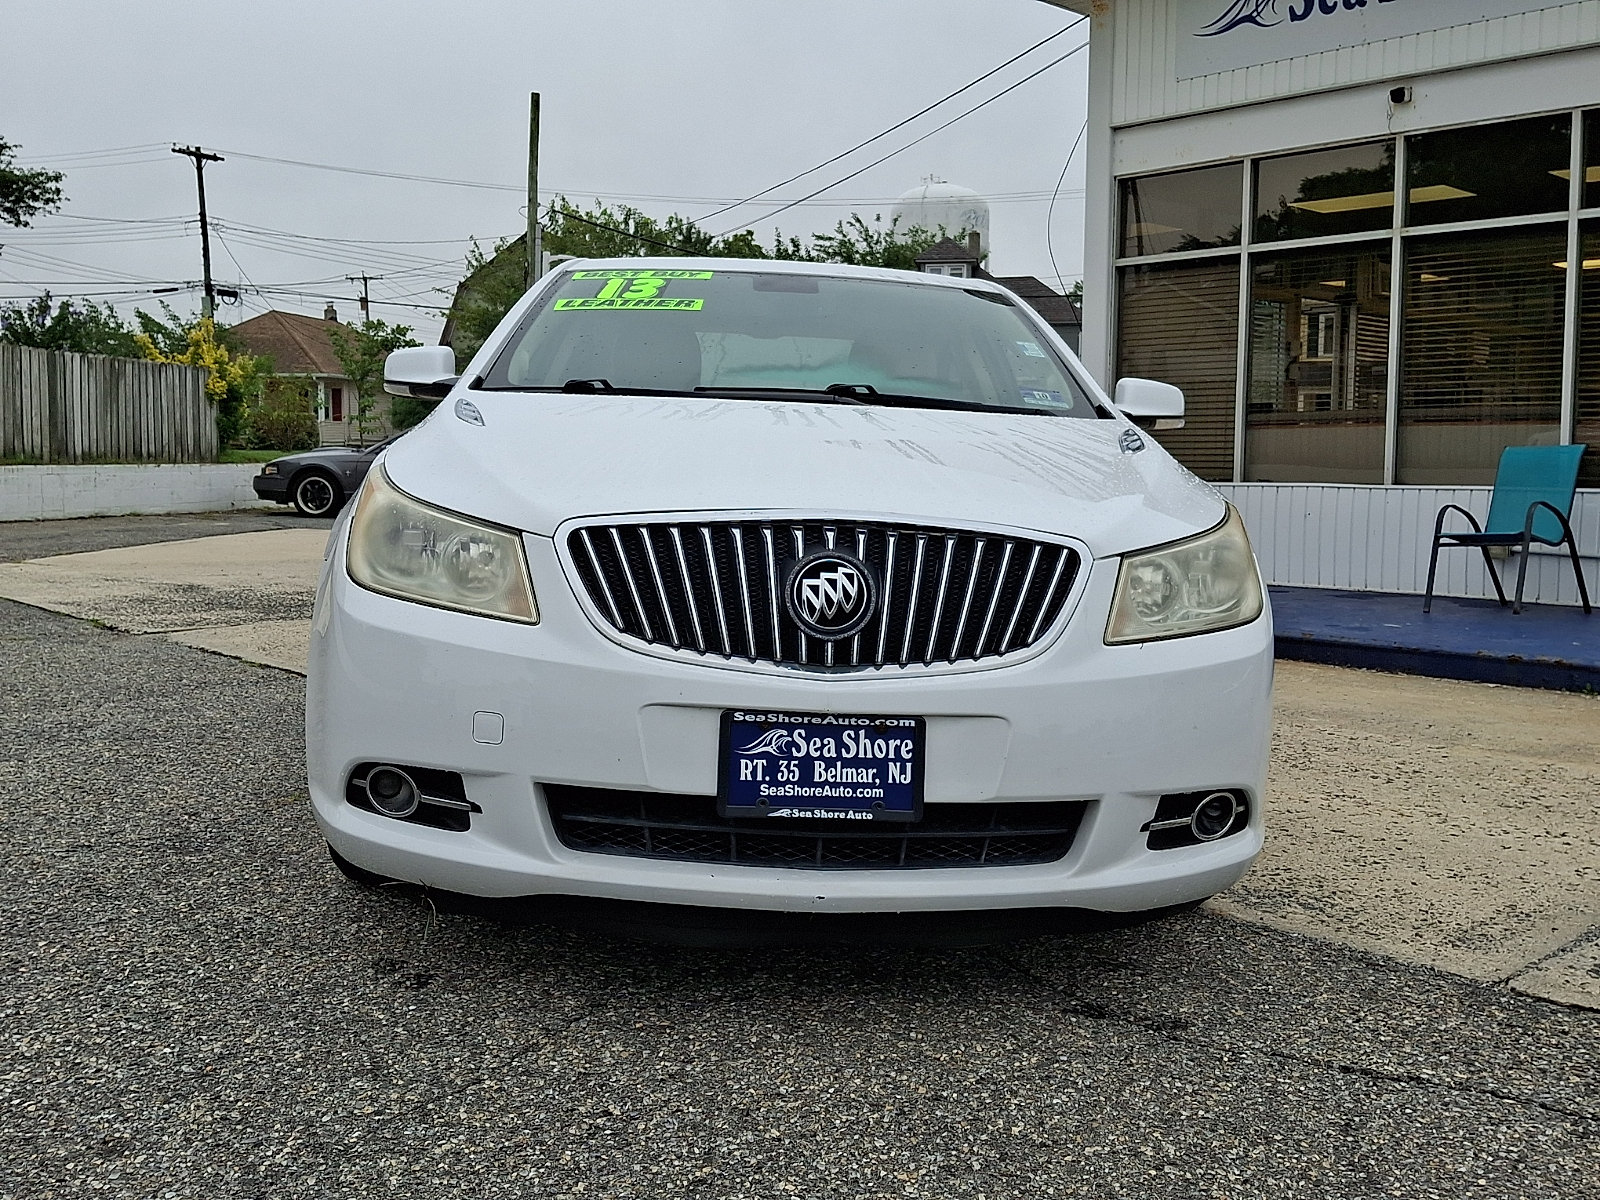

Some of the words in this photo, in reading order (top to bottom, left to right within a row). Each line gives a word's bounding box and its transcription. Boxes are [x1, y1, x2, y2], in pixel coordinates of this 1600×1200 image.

[596, 277, 667, 300] 13
[561, 299, 695, 308] LEATHER
[733, 712, 915, 727] SeaShoreAuto.com
[791, 729, 837, 758] Sea
[841, 729, 913, 759] Shore
[739, 759, 770, 782] RT.
[777, 760, 800, 782] 35
[813, 761, 881, 786] Belmar,
[887, 762, 912, 784] NJ
[759, 783, 884, 798] SeaShoreAuto.com
[791, 808, 813, 818] Sea
[813, 809, 846, 819] Shore
[846, 811, 873, 820] Auto
